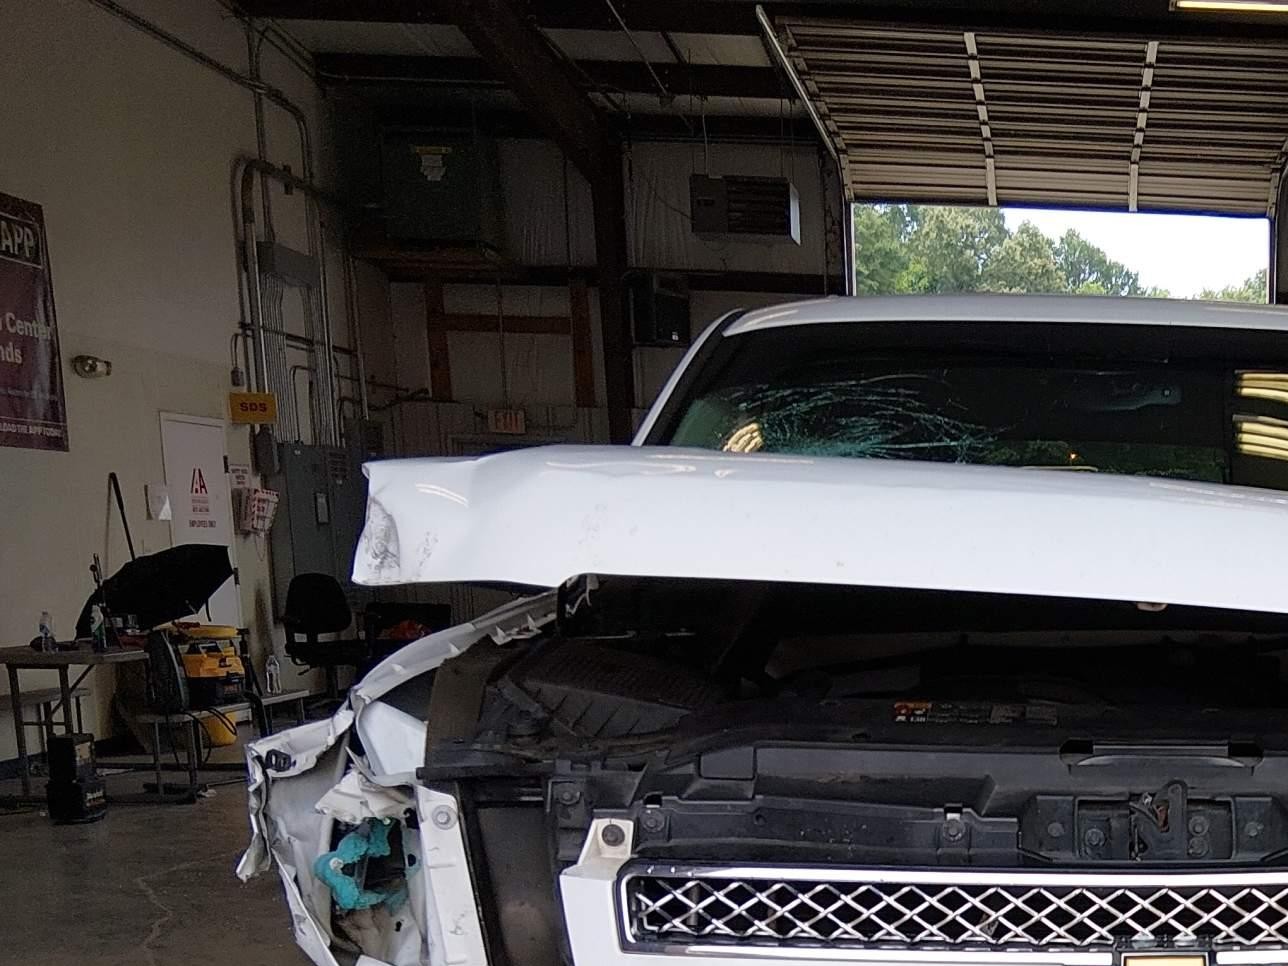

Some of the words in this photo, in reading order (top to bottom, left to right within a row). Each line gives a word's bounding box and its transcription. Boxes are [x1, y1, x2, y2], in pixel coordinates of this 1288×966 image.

[0, 220, 34, 258] APP
[5, 312, 51, 341] Center
[239, 402, 268, 413] SDS
